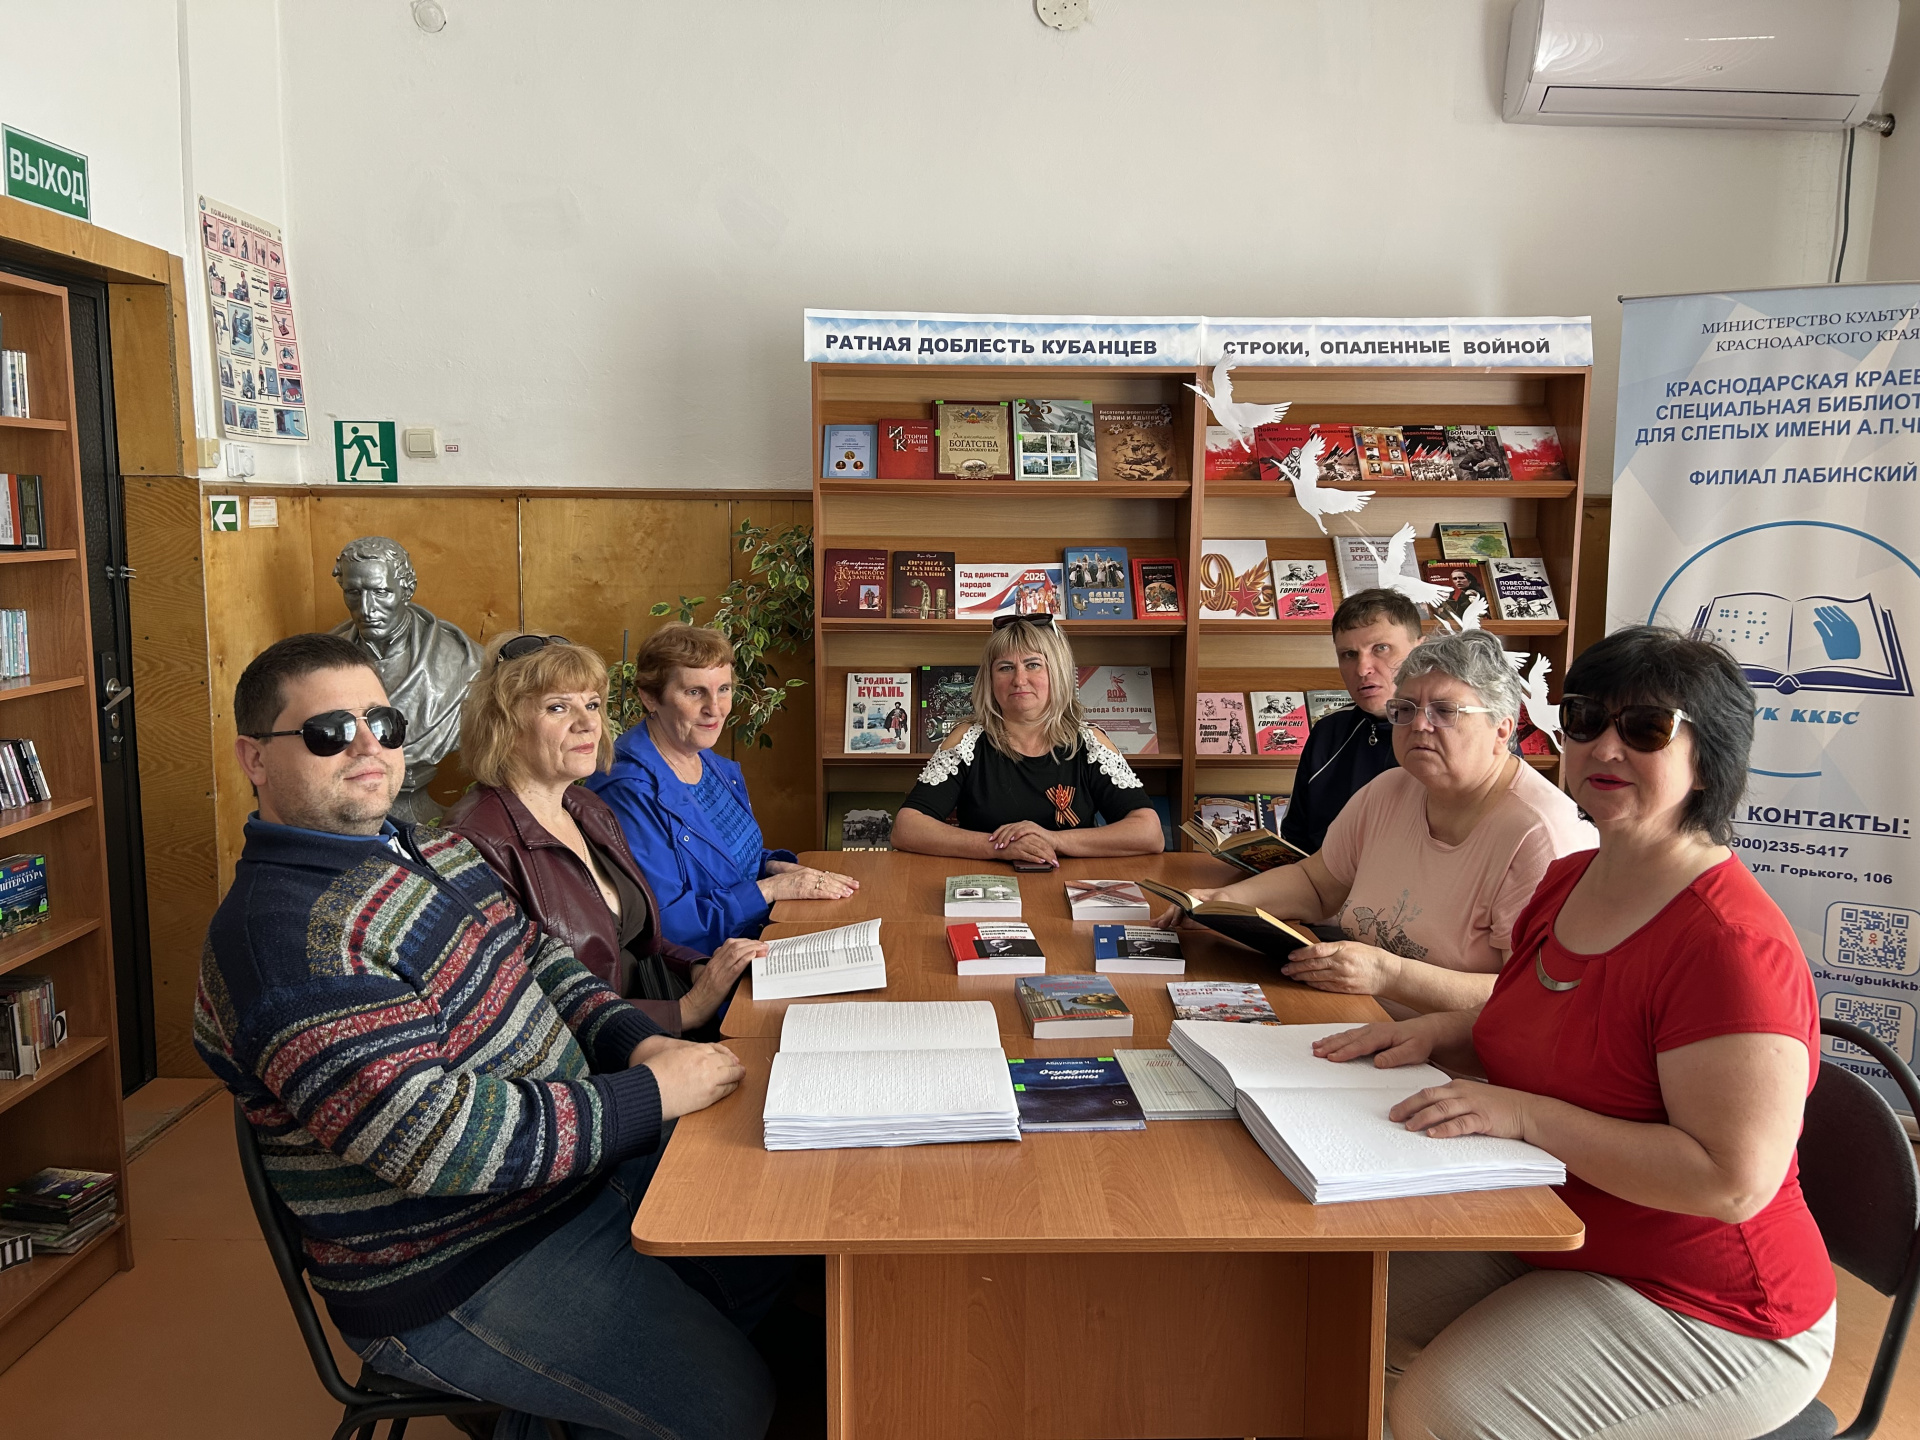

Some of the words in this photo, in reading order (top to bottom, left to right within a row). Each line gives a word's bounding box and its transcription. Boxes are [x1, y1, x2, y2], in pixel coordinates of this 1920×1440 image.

[9, 146, 86, 208] ВЫХОД
[1700, 312, 1842, 335] МИНИСТЕРСТВО
[1845, 306, 1920, 326] КУЛЬТУР
[825, 334, 912, 352] РАТНАЯ
[917, 337, 1035, 356] ДОБЛЕСТЬ
[1042, 339, 1158, 358] КУБАНЦЕВ
[1222, 340, 1310, 358] СТРОКИ,
[1319, 339, 1451, 355] ОПАЛЕННЫЕ
[1463, 338, 1551, 355] ВОЙНОЙ
[1715, 330, 1873, 352] КРАСНОДАРСКОГО
[1876, 327, 1920, 343] КРАЯ
[1665, 371, 1849, 398] КРАСНОДАРСКАЯ
[1655, 397, 1811, 421] СПЕЦИАЛЬНАЯ
[1634, 427, 1676, 446] ДЛЯ
[1680, 421, 1770, 442] СЛЕПЫХ
[1774, 419, 1851, 439] ИМЕНИ
[1856, 417, 1920, 436] А.П.Ч
[948, 439, 999, 448] БОГАТСТВА
[1689, 468, 1777, 486] ФИЛИАЛ
[1781, 461, 1918, 485] ЛАБИНСКИЙ
[959, 571, 973, 579] Год
[974, 571, 1009, 579] единства
[1024, 572, 1046, 581] 2026
[959, 590, 987, 598] России
[863, 676, 894, 685] РОДНАЯ
[857, 685, 905, 699] КУБАНЬ
[1198, 723, 1218, 731] Повесть
[1790, 708, 1860, 725] ККБС
[1747, 805, 1911, 836] контакты:
[1752, 863, 1775, 874] ул.
[1780, 863, 1858, 883] Горького,
[1863, 872, 1893, 884] 106
